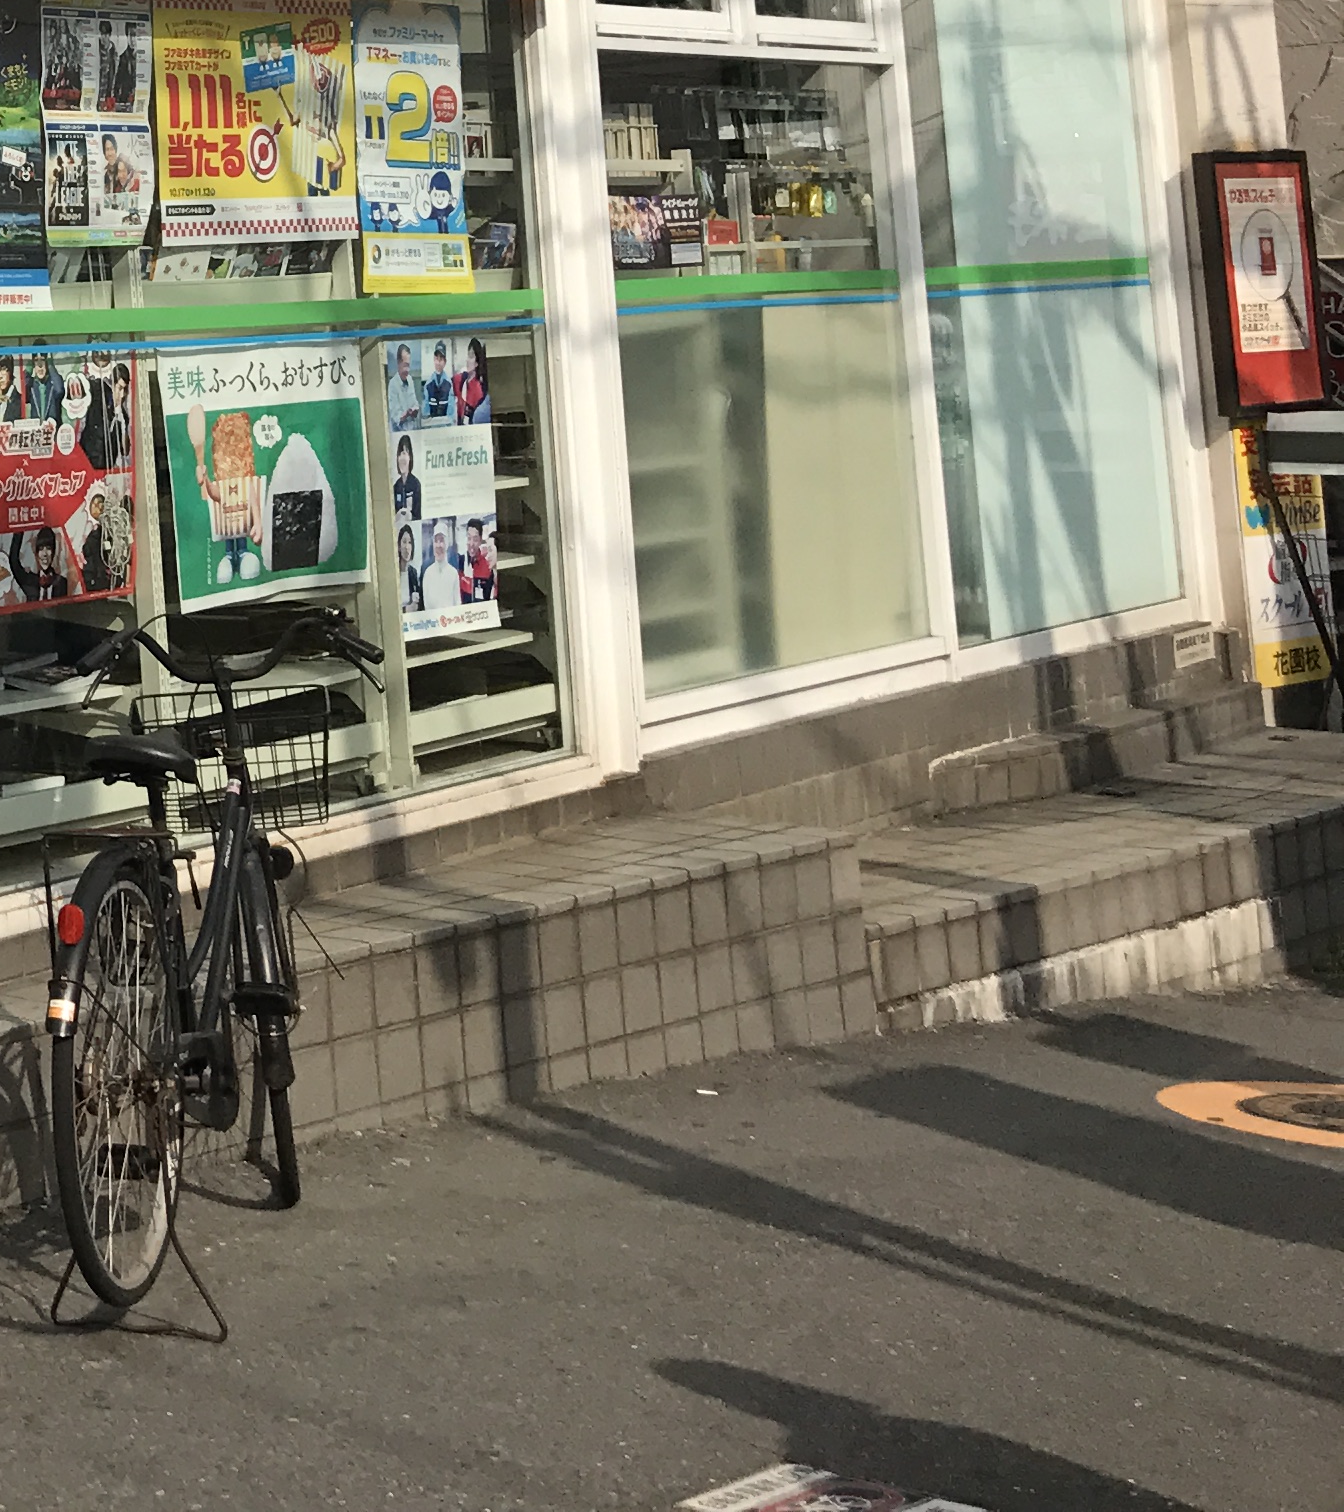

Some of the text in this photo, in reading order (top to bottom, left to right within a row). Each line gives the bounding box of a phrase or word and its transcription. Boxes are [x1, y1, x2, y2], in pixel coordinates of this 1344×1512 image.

[168, 134, 245, 178] 当たる
[167, 356, 355, 400] 美味ふっくら、おむすび。
